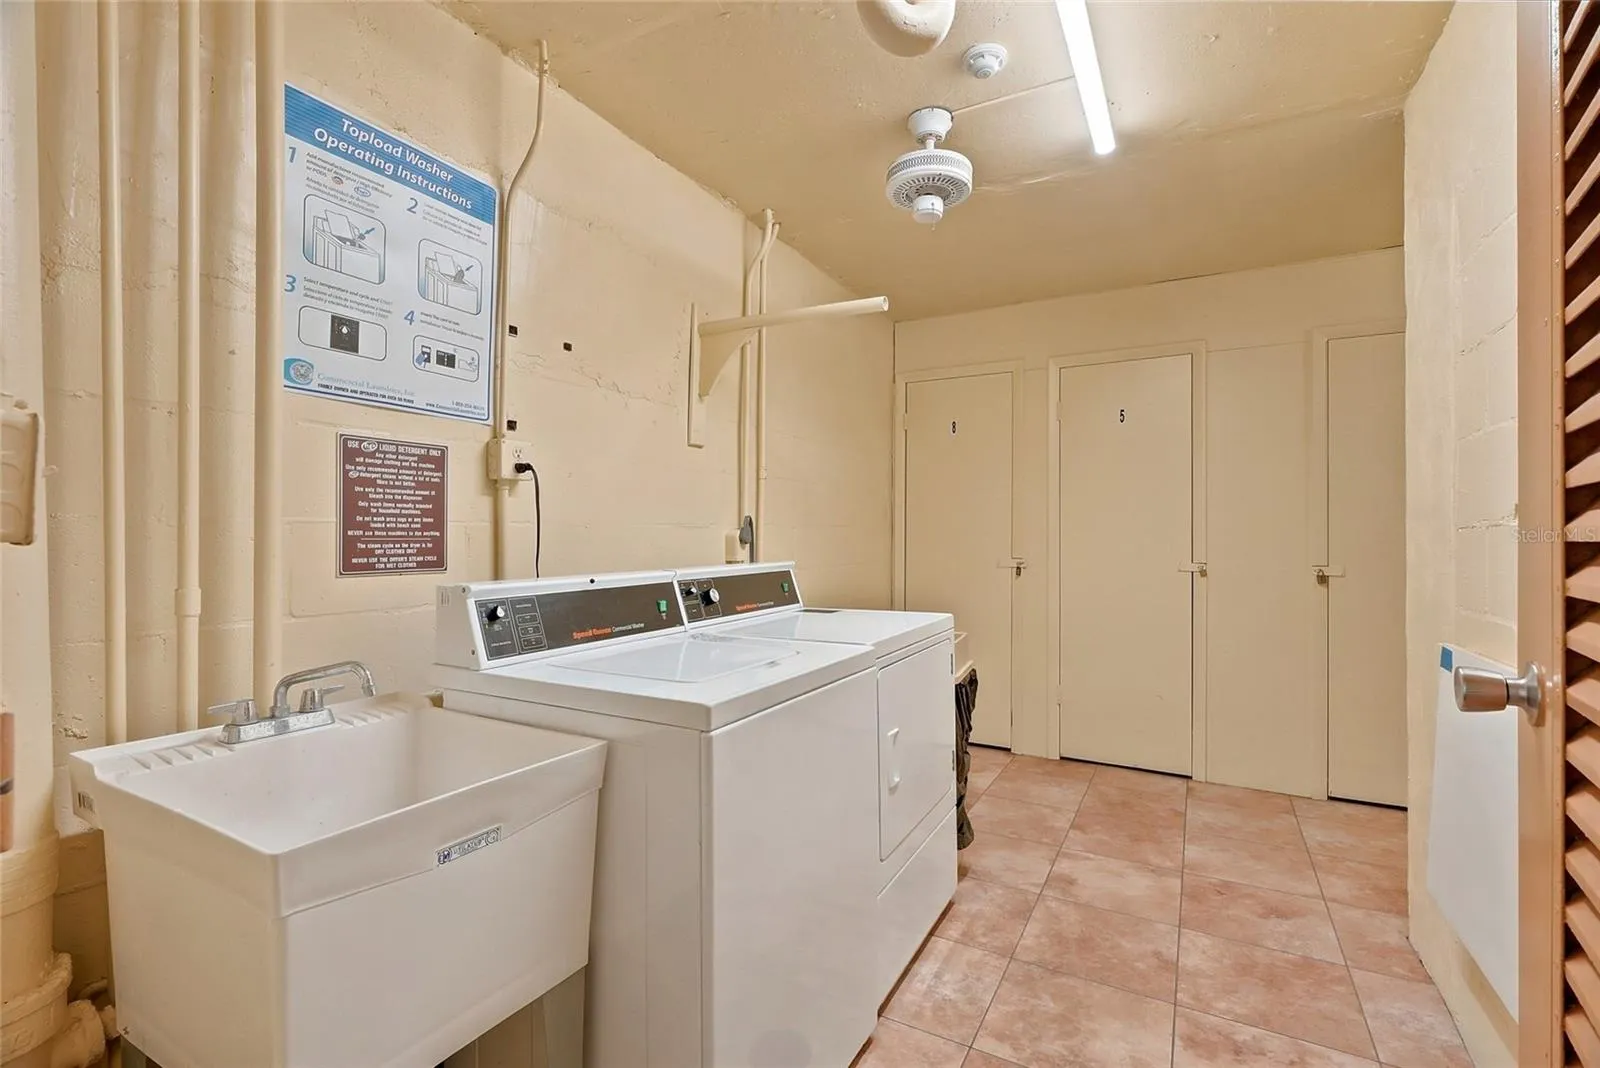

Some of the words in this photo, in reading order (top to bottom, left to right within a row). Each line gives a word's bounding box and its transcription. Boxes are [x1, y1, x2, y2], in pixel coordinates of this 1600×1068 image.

[288, 146, 297, 163] 1
[341, 118, 403, 158] Topload
[405, 150, 454, 181] Washer
[314, 127, 395, 175] Operating
[397, 165, 473, 209] Instructions
[406, 198, 418, 214] 2
[284, 275, 297, 292] 3
[404, 310, 415, 325] 4
[1120, 409, 1125, 423] 5
[952, 421, 956, 434] 8
[348, 440, 359, 448] USE
[380, 444, 396, 452] LIQUID
[398, 446, 428, 455] DETERGENT
[573, 630, 592, 640] Speed
[592, 627, 612, 636] Queen
